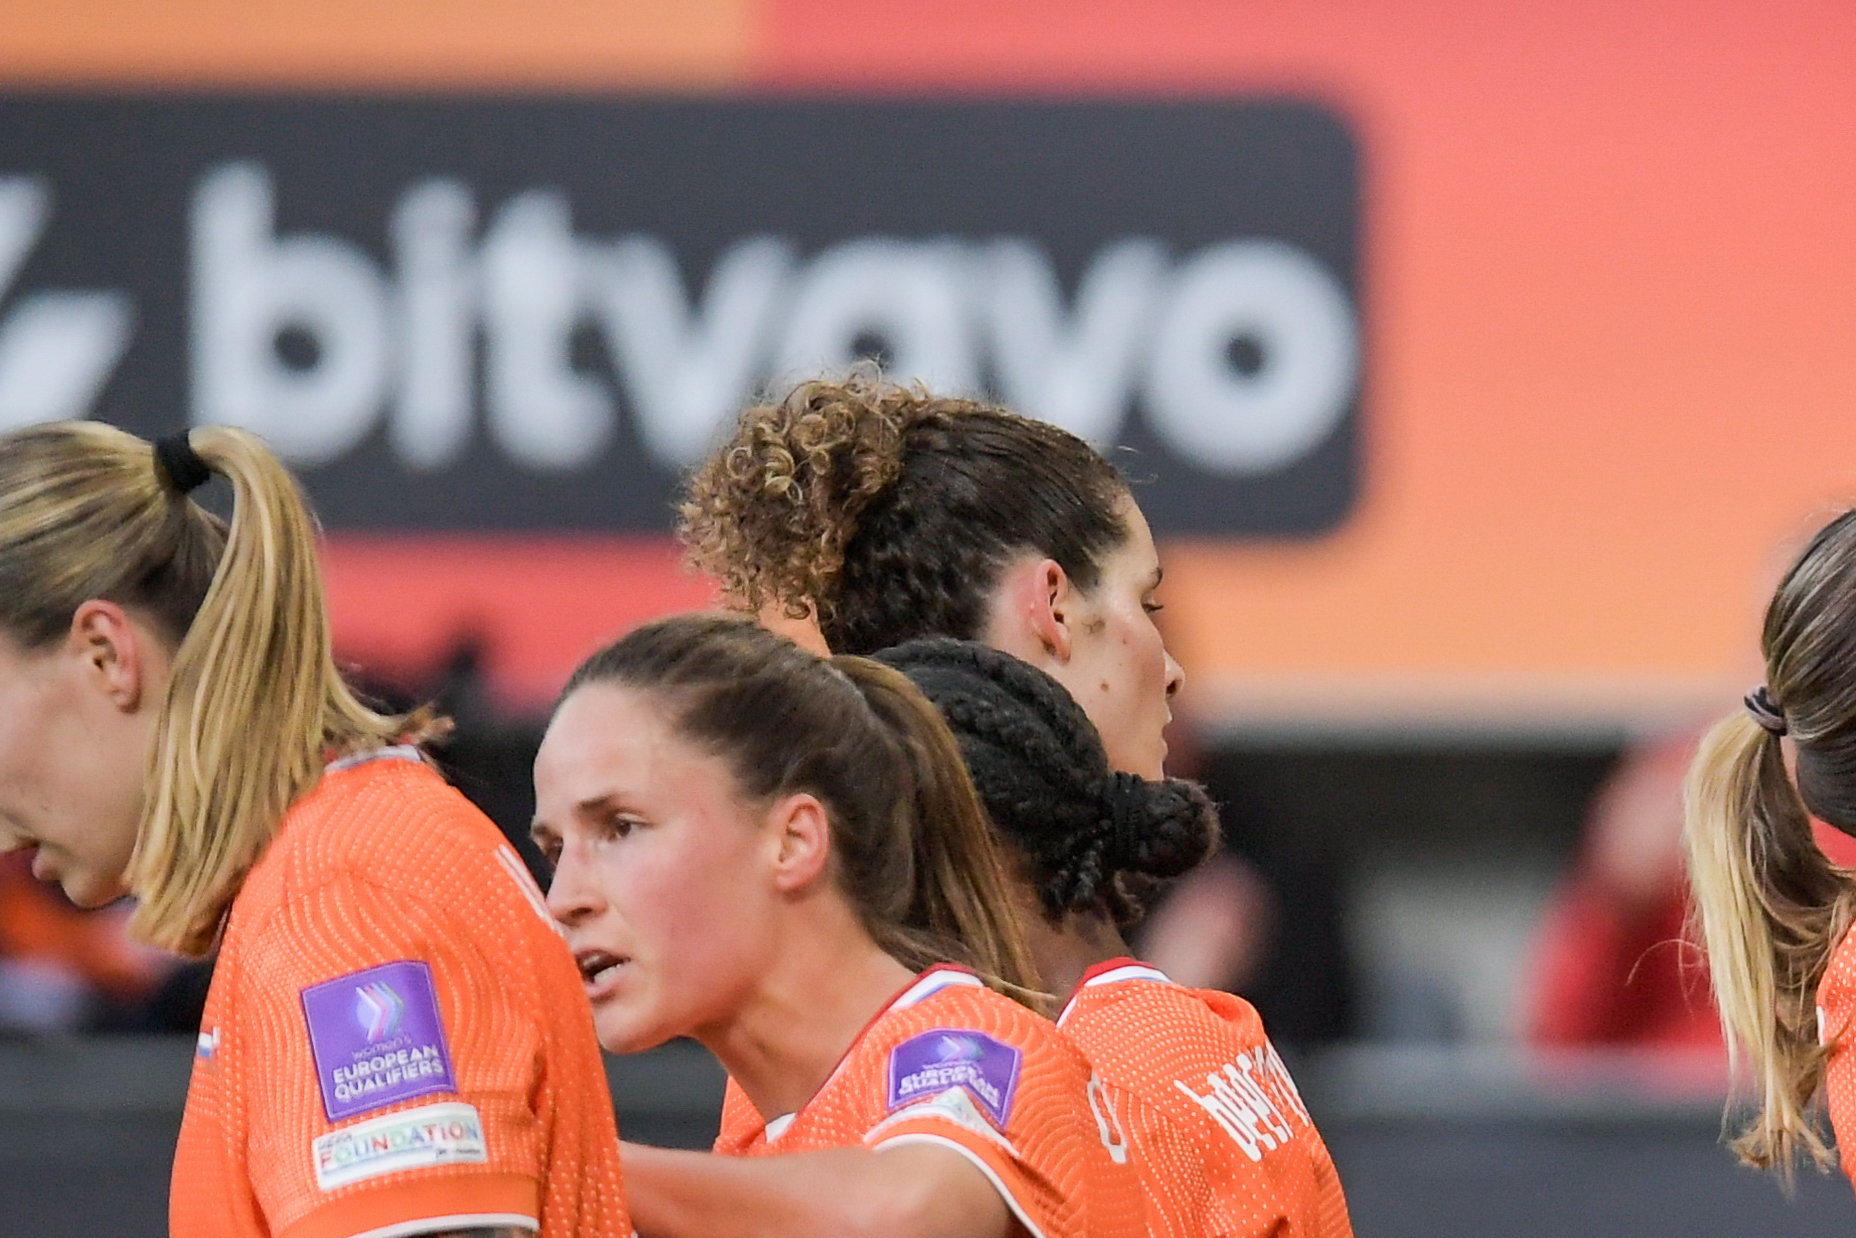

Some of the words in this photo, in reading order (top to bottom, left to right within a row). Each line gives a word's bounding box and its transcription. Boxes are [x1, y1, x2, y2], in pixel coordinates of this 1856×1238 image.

[333, 1044, 439, 1083] EUROPEAN
[334, 1058, 445, 1101] QUALIFIERS
[319, 1120, 480, 1170] FOUNDATION
